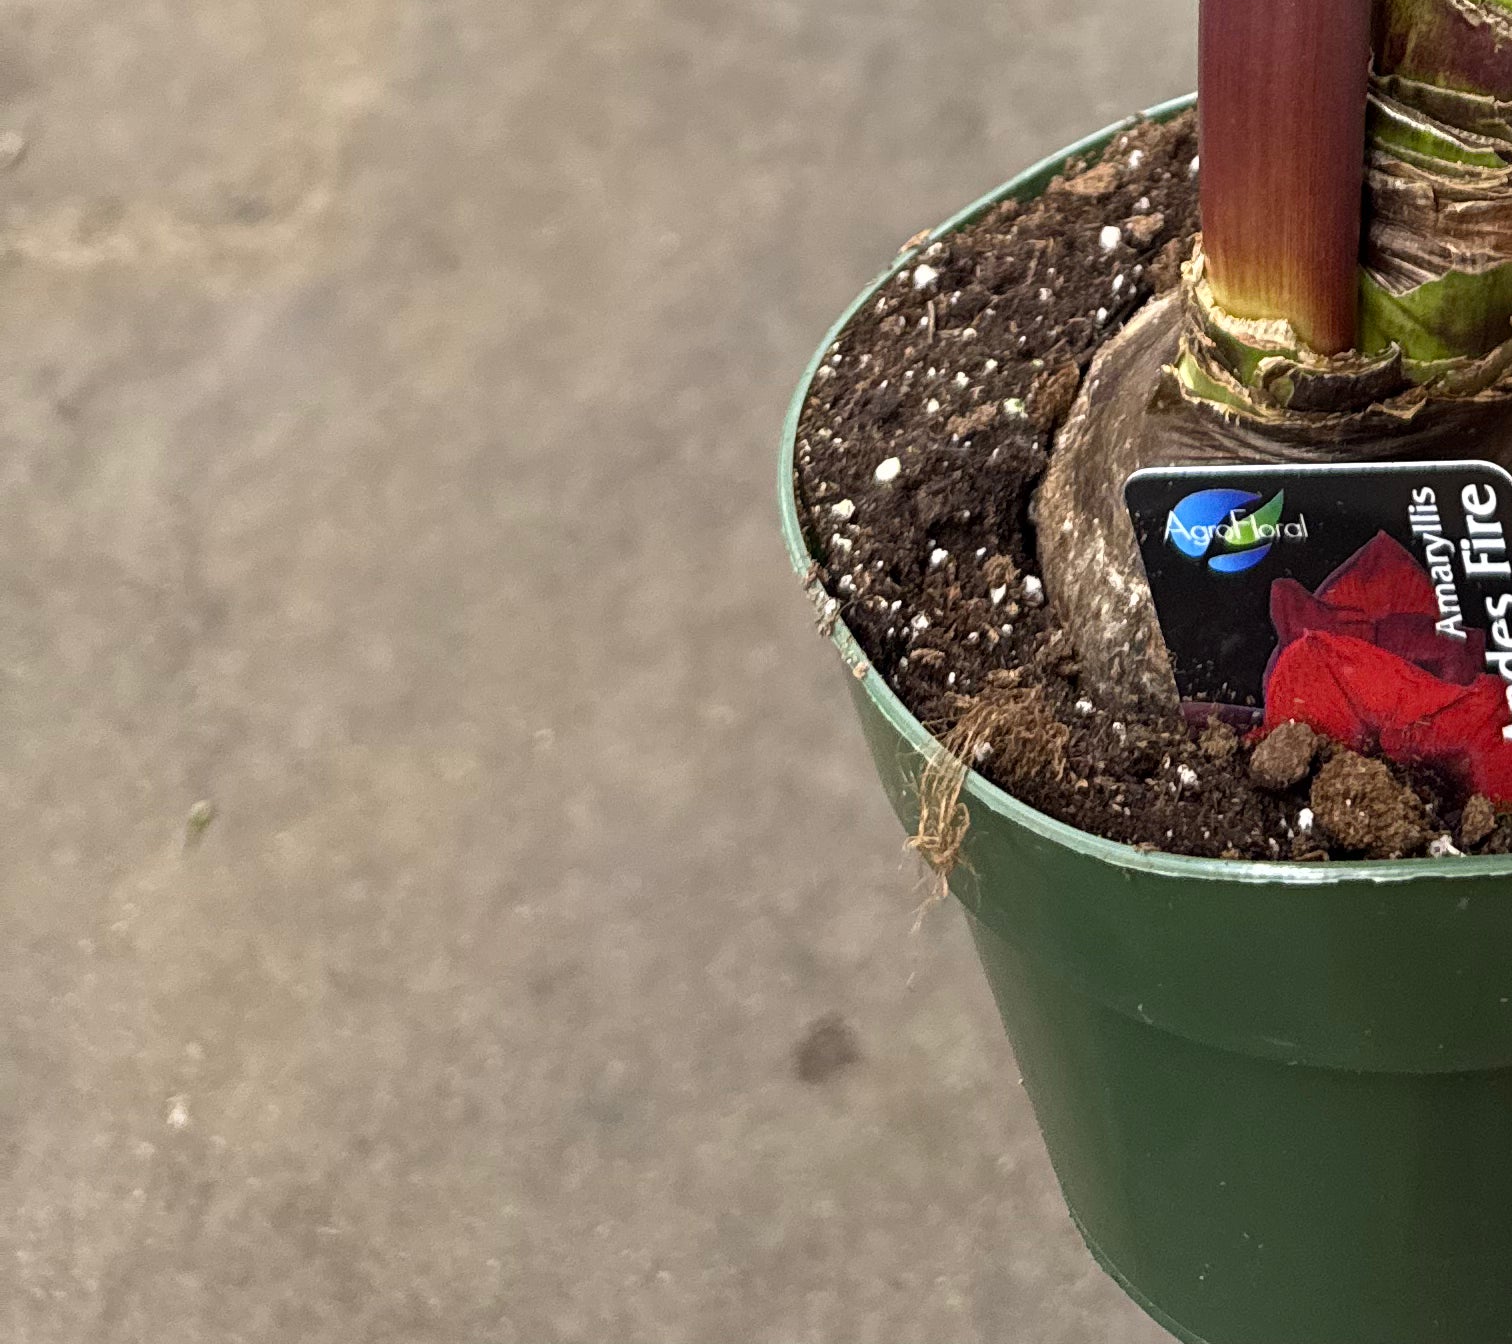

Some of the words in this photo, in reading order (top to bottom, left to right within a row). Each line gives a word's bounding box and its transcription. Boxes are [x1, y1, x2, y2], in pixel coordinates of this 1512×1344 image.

[1163, 508, 1308, 546] AgroFloral
[1408, 486, 1467, 640] Amaryllis
[1460, 482, 1512, 579] Fire
